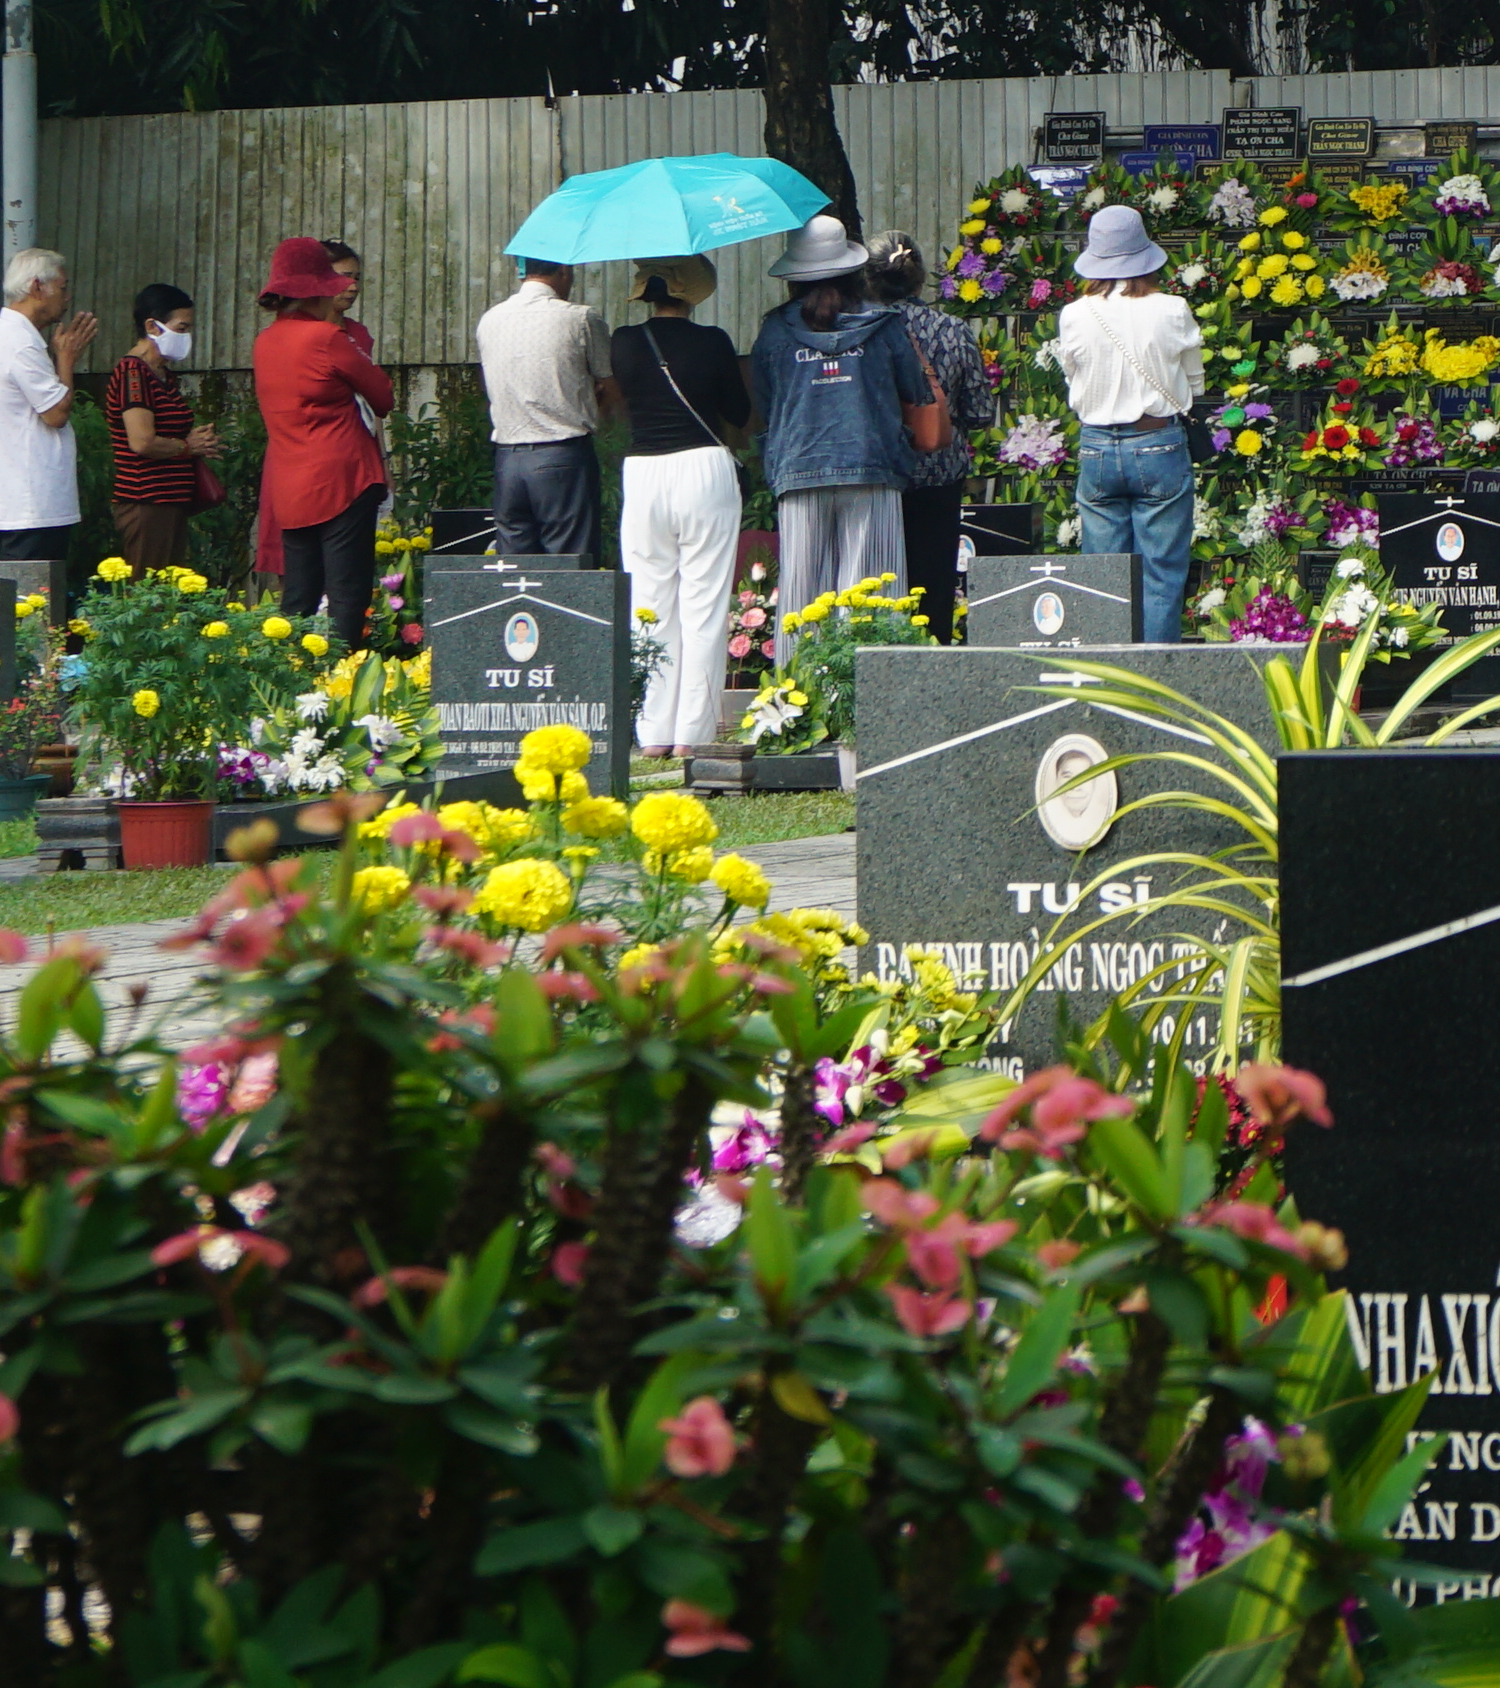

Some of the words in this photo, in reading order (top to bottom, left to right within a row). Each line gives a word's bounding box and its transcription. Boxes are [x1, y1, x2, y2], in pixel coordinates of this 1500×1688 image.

[796, 344, 865, 363] CLACS
[1423, 566, 1452, 581] TU
[1457, 563, 1478, 580] SĨ
[486, 669, 522, 688] TU
[528, 665, 556, 687] SĨ
[1007, 882, 1081, 914] TU
[1100, 875, 1153, 913] SĨ
